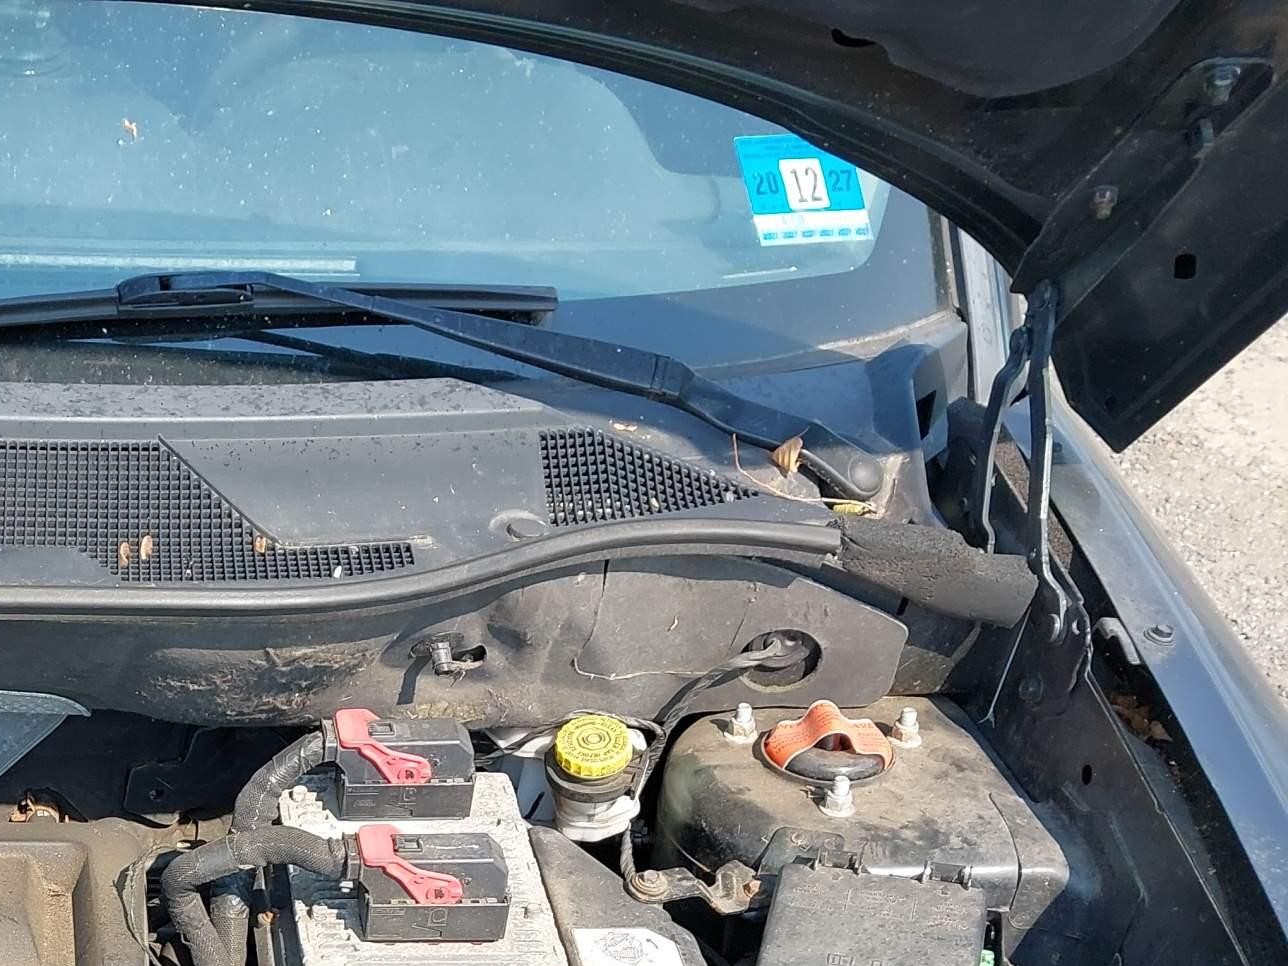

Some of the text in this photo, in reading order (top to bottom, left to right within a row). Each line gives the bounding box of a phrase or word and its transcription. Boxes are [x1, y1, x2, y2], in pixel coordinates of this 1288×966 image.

[752, 168, 852, 203] 20 12 27
